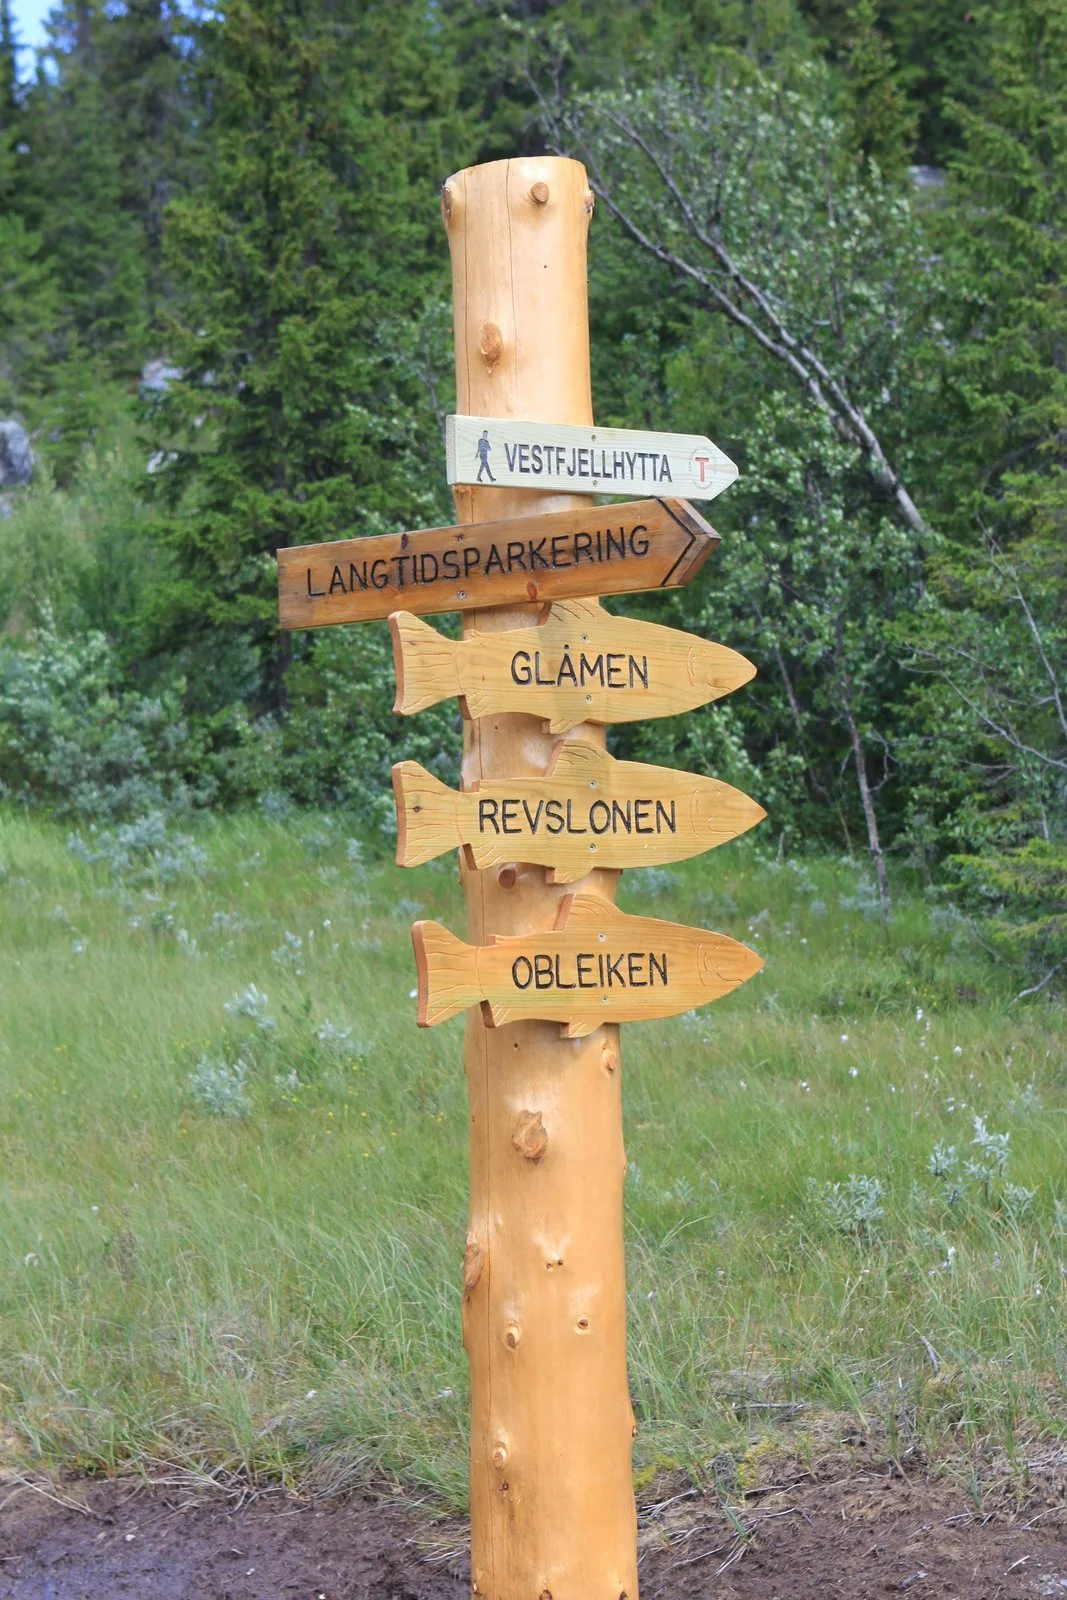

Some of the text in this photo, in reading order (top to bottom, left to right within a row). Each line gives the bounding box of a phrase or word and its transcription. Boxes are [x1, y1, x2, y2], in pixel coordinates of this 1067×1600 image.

[504, 443, 673, 483] VESTFJELLHYTTA
[695, 457, 710, 483] T
[307, 525, 650, 597] LANGTIDSPARKERING
[511, 644, 649, 689] GLÅMEN
[479, 799, 676, 834] REVSLONEN
[511, 953, 669, 990] OBLEIKEN
